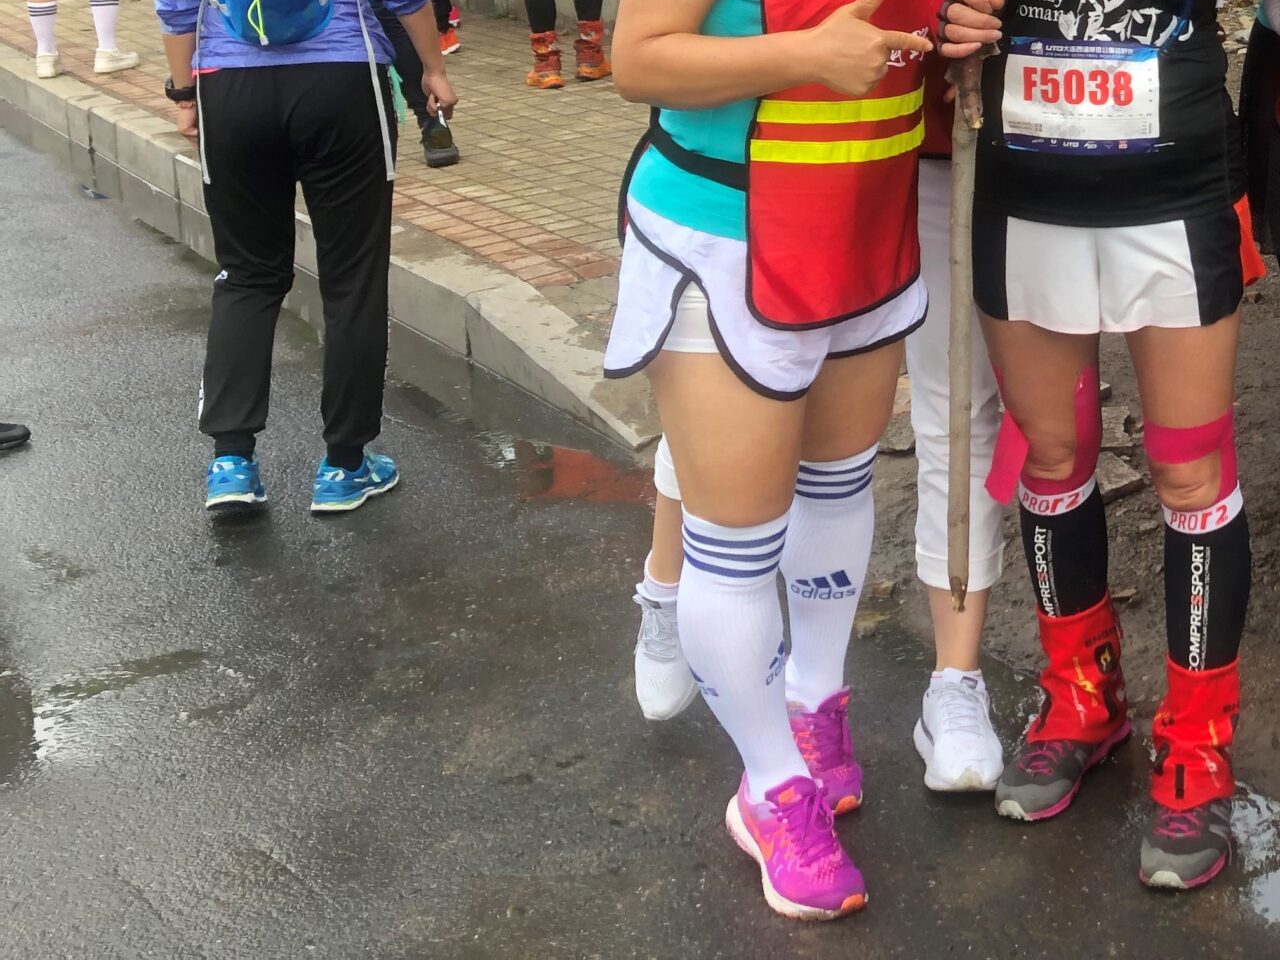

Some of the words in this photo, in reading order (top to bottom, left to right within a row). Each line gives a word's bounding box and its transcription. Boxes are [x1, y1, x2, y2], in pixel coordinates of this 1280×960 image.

[1017, 4, 1066, 23] oman
[1023, 66, 1134, 107] F5038
[1034, 525, 1056, 619] MPRESSPORT
[791, 584, 856, 600] adidas
